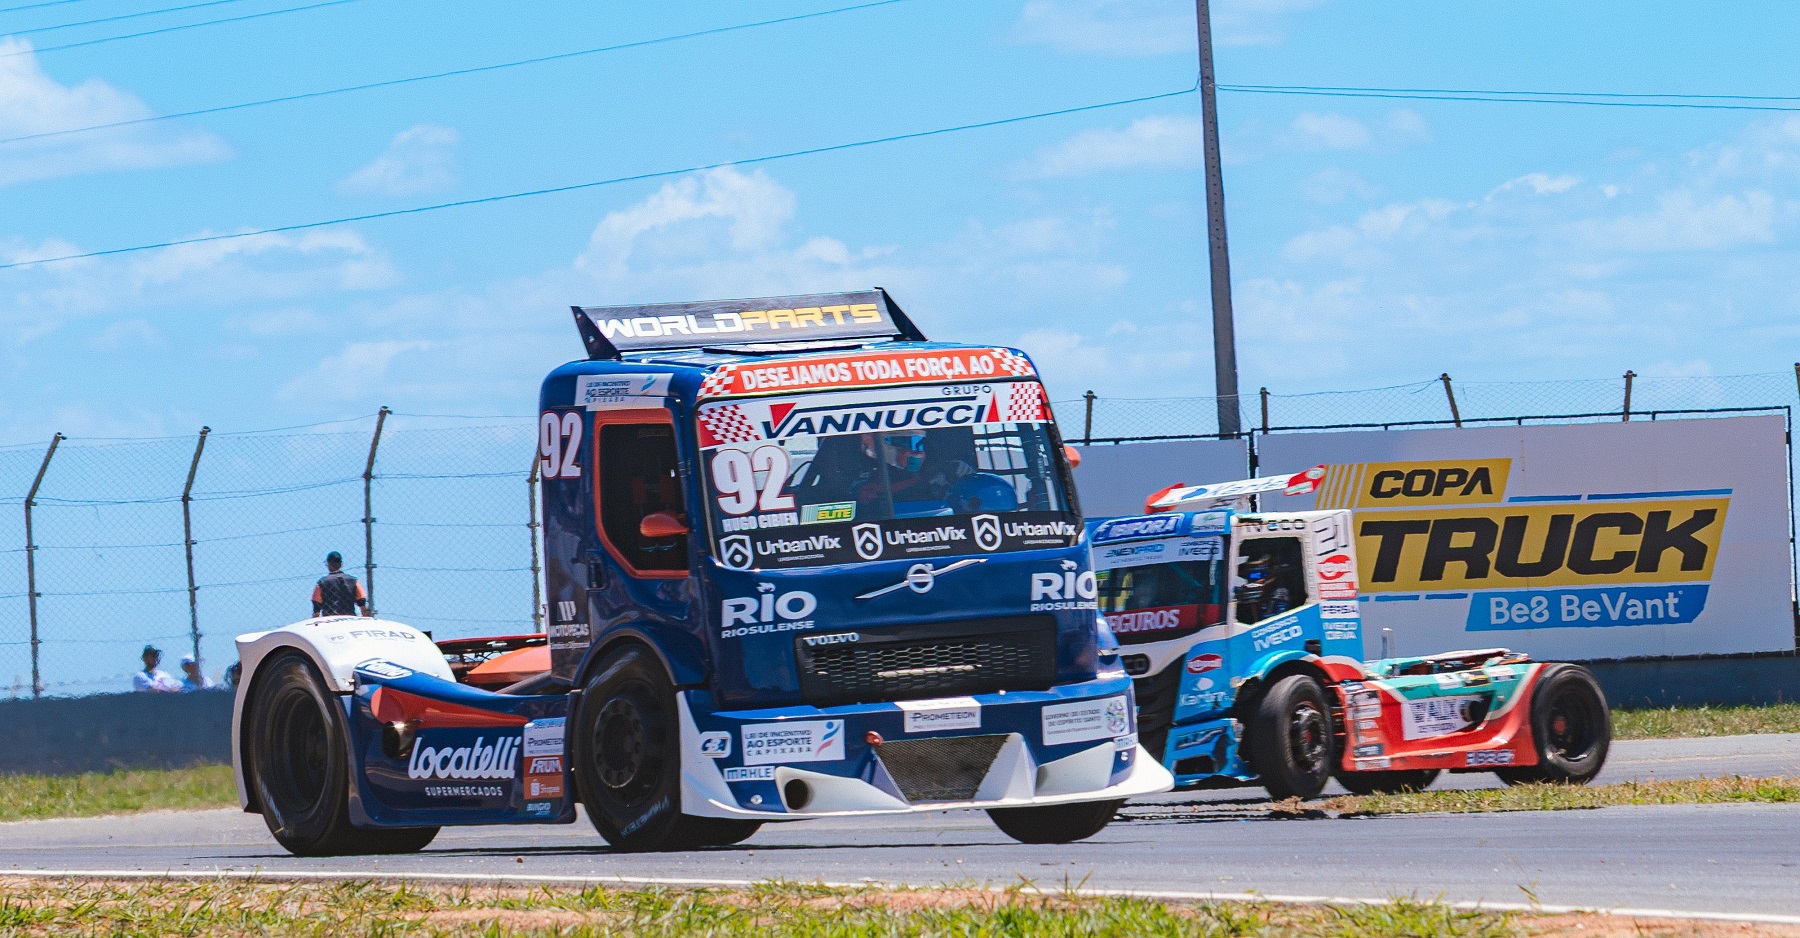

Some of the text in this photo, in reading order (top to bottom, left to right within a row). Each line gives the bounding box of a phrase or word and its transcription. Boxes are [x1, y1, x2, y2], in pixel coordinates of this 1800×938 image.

[598, 303, 882, 338] WORLDPARTS
[740, 354, 995, 390] DESEJAMOS TODA FORÇA AO
[942, 385, 992, 396] GRUPO
[762, 403, 986, 439] VANNUCCI
[540, 411, 583, 479] 92
[712, 445, 795, 516] 92
[1370, 467, 1493, 499] COPA
[722, 516, 758, 532] HUGO
[817, 508, 852, 520] ELITE
[756, 521, 1077, 556] UrbanVix UrbanVix UrbanVix
[1360, 508, 1718, 583] TRUCK
[721, 583, 818, 628] RIO
[1489, 597, 1551, 625] Be8
[348, 630, 416, 640] FIRAD
[721, 620, 816, 639] RIOSULENSE
[802, 632, 860, 647] VOLVO
[1253, 625, 1303, 652] IVECO
[911, 712, 976, 722] PROMETEON
[747, 737, 812, 749] AO ESPORTE
[747, 747, 812, 757] CAPIXABA
[408, 736, 522, 779] locatelli
[528, 757, 563, 774] FRUM
[726, 768, 771, 779] MAHLE
[425, 786, 503, 796] SUPERMERCADOS
